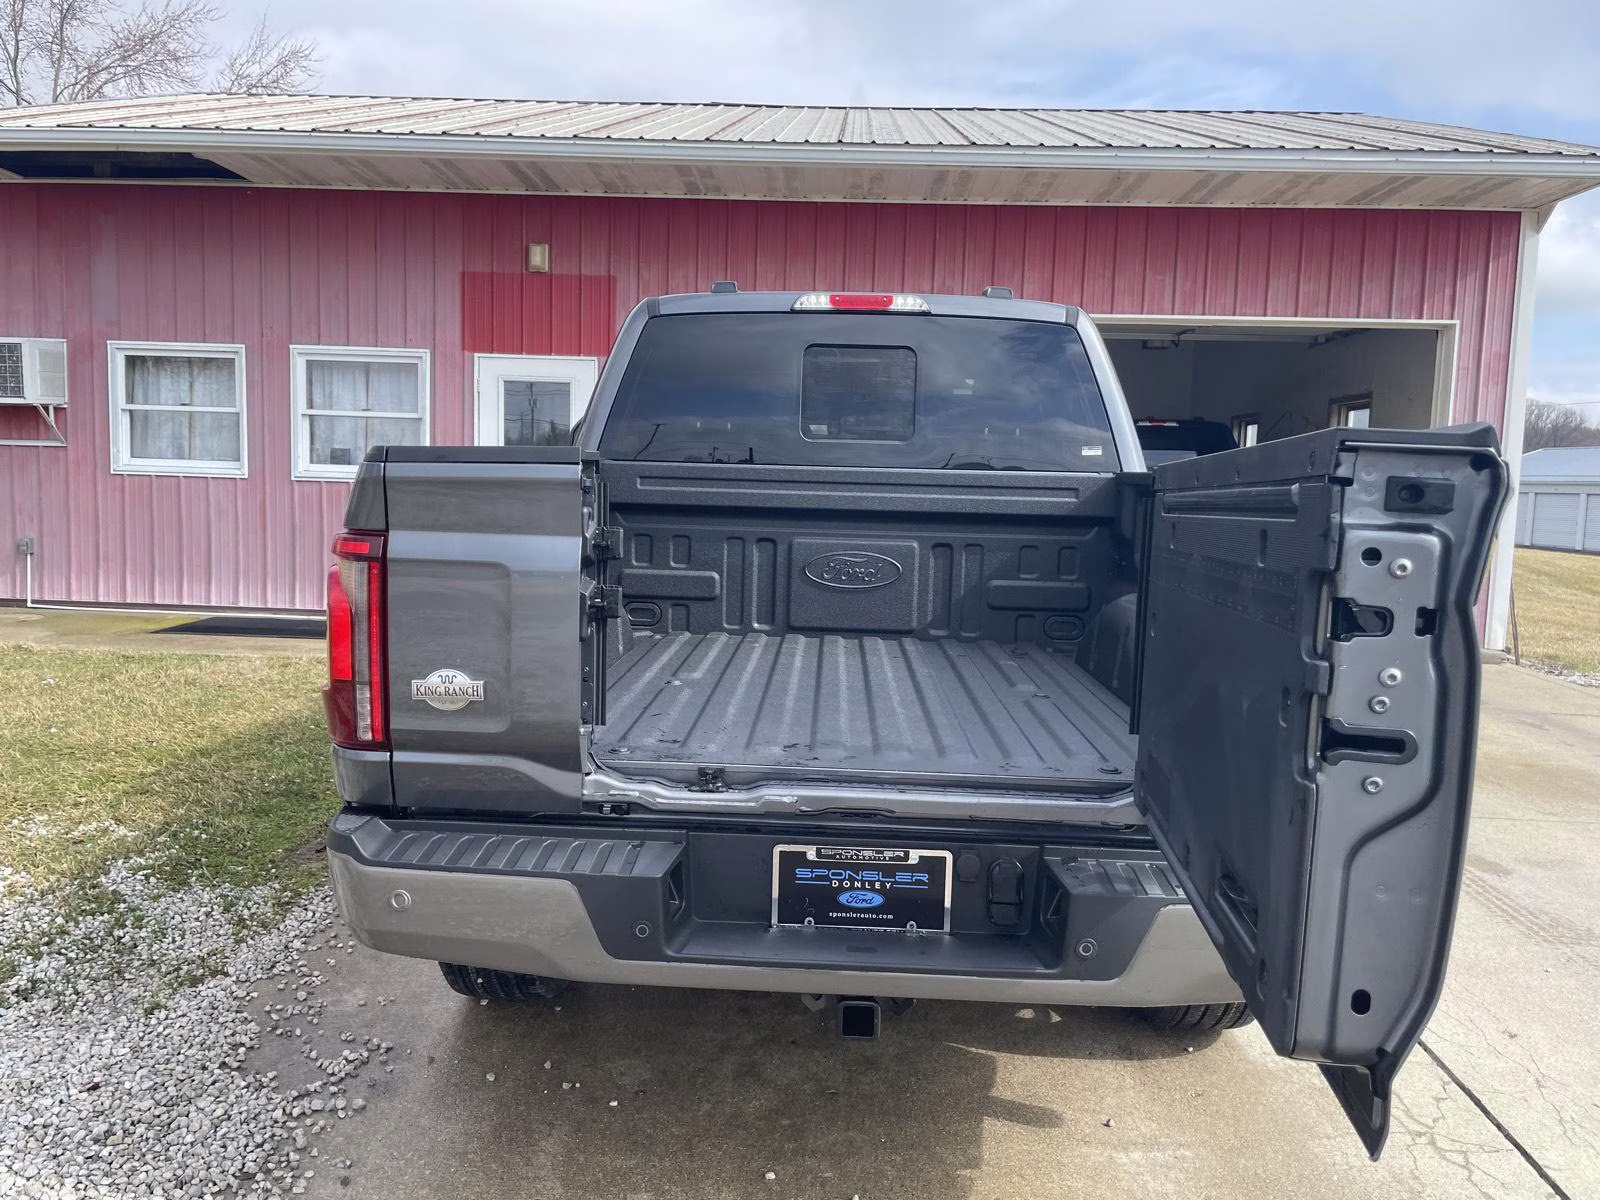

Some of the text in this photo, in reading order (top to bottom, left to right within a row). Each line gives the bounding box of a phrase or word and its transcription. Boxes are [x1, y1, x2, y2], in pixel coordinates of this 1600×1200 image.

[823, 556, 882, 580] Ford
[416, 684, 479, 697] KING RANCH
[821, 849, 904, 858] SPONSLER
[795, 868, 928, 883] SPONSLER
[831, 879, 892, 889] DONLEY
[845, 892, 875, 905] Ford
[828, 911, 894, 919] sponslerauto.com
